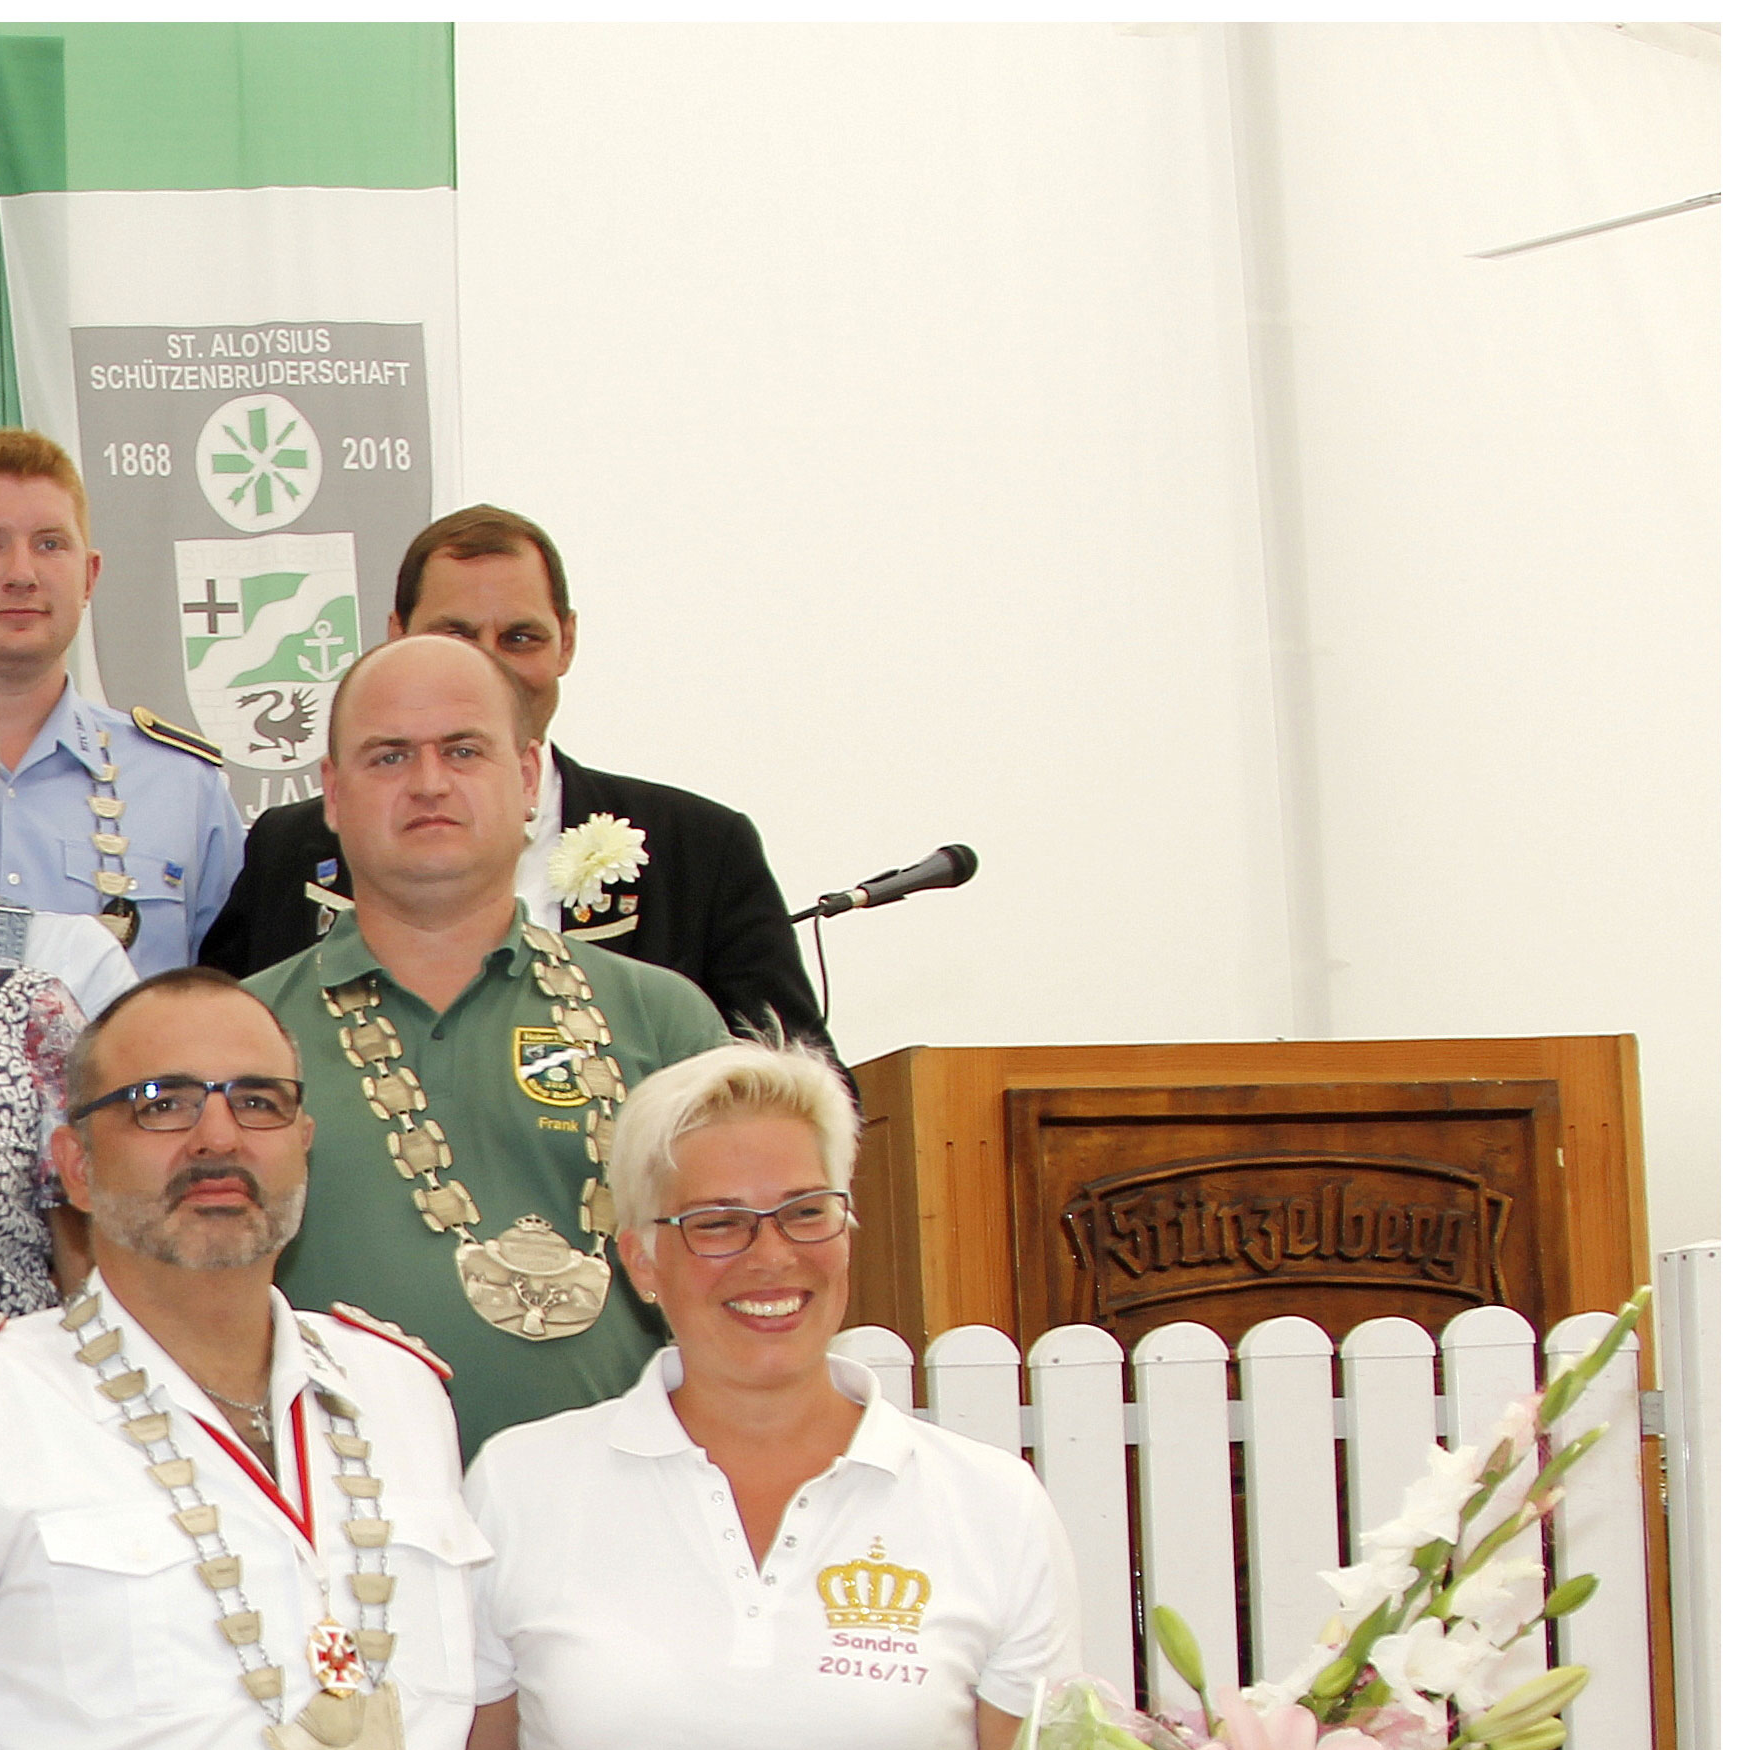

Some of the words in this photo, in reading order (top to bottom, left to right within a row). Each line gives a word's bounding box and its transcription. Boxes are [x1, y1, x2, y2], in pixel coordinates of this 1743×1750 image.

[167, 334, 203, 359] ST.
[212, 329, 330, 358] ALOYSIUS
[90, 359, 410, 391] SCHÜTZENBRUDERSCHAFT
[103, 442, 172, 478] 1868
[342, 437, 412, 472] 2018
[538, 1115, 580, 1133] Frank
[1109, 1179, 1477, 1283] Stürzelberg
[832, 1632, 918, 1655] Sandra
[819, 1656, 929, 1685] 2016/17
